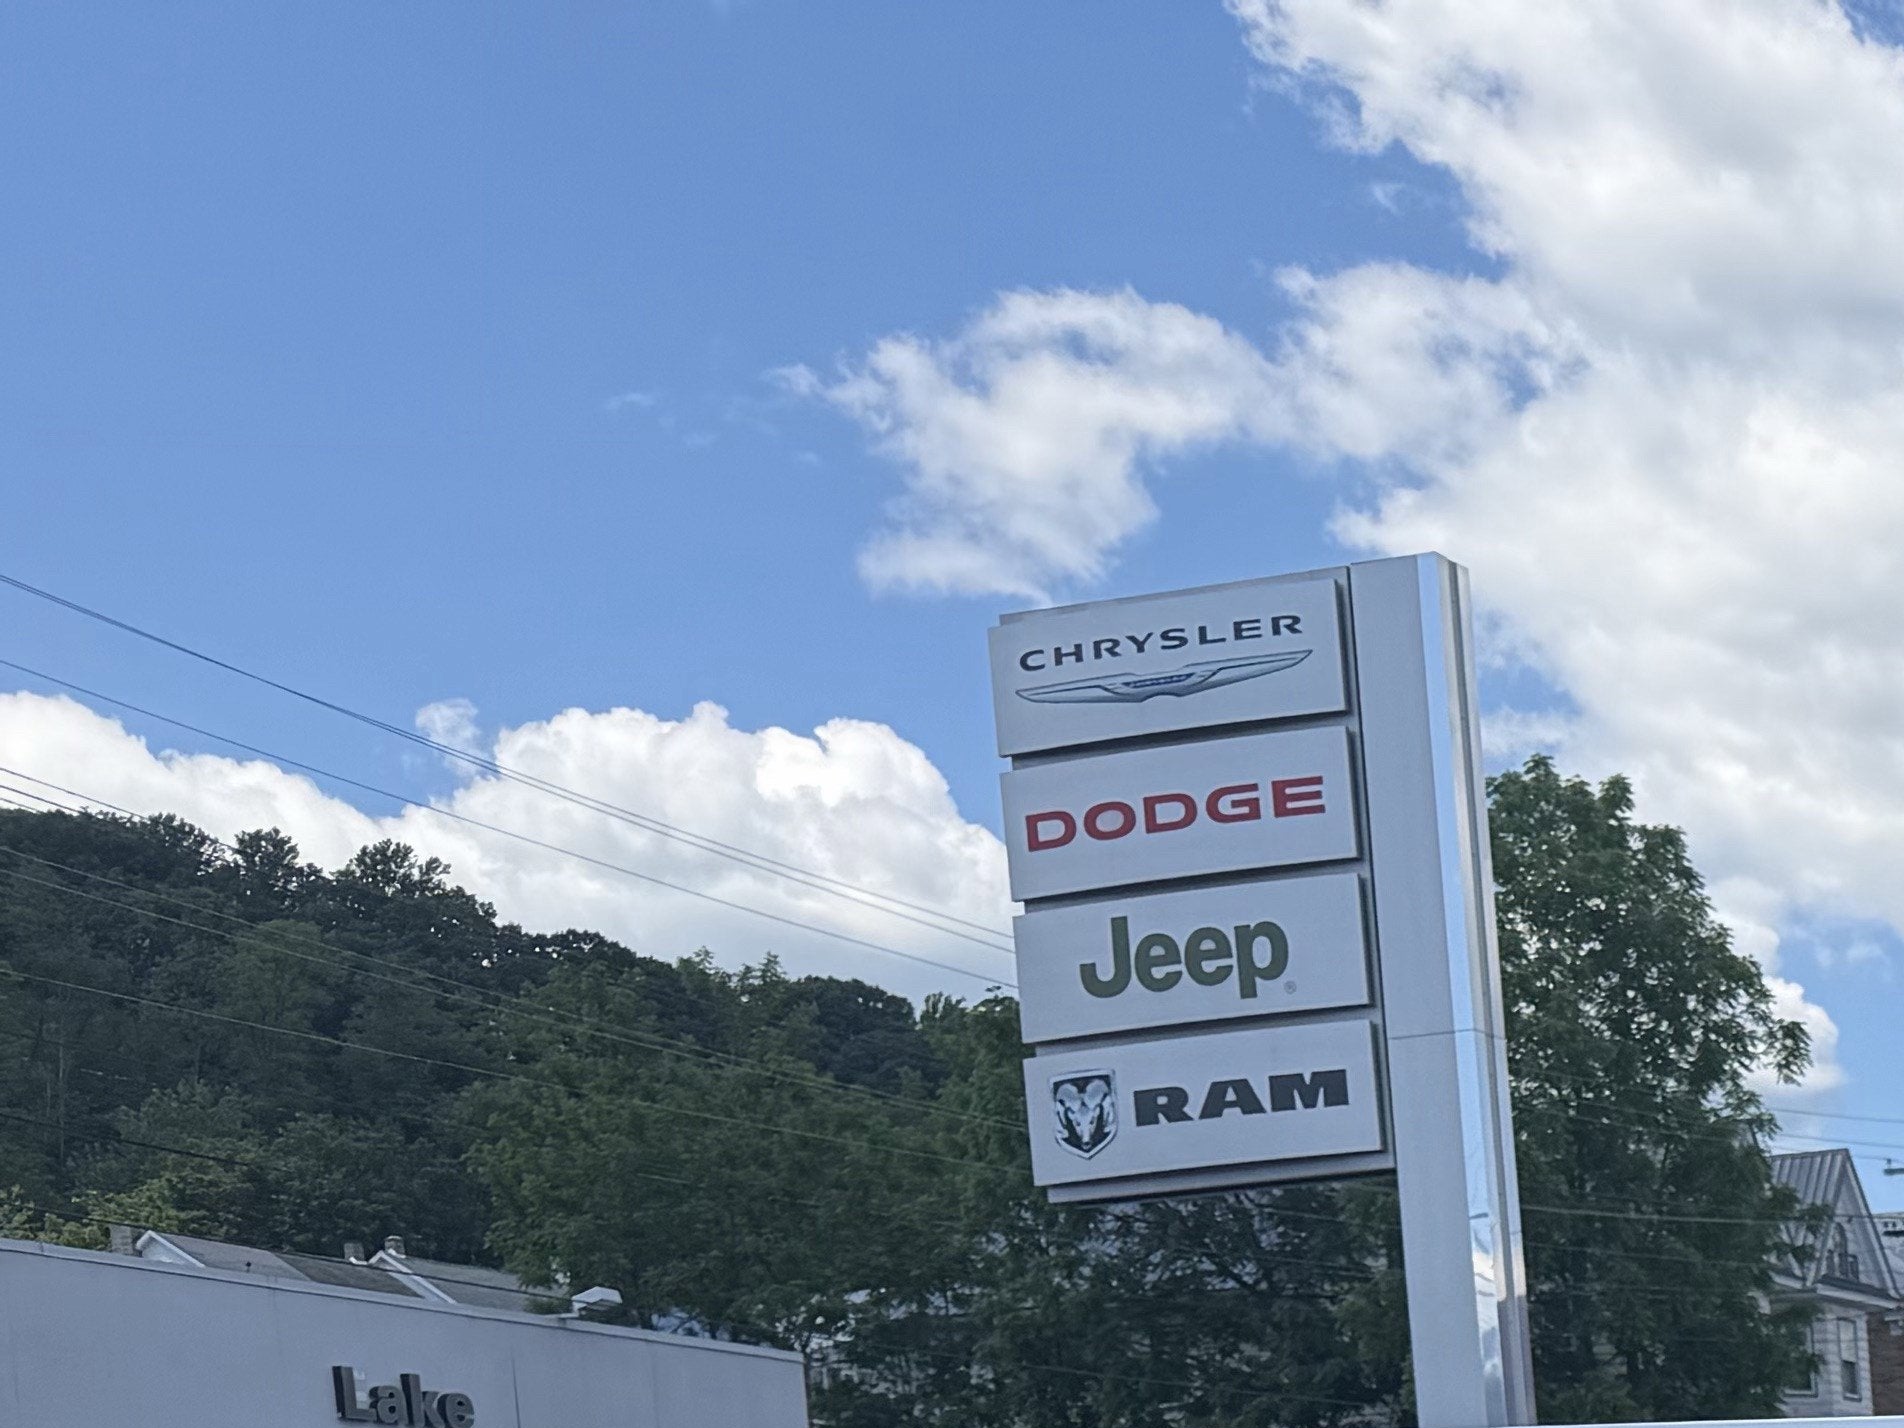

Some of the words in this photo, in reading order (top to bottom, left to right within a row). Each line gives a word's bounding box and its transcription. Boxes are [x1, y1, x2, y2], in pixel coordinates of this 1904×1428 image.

[1018, 613, 1304, 672] CHRYSLER
[1024, 774, 1327, 853] DODGE
[1078, 915, 1290, 1000] Jeep
[1133, 1067, 1351, 1128] RAM
